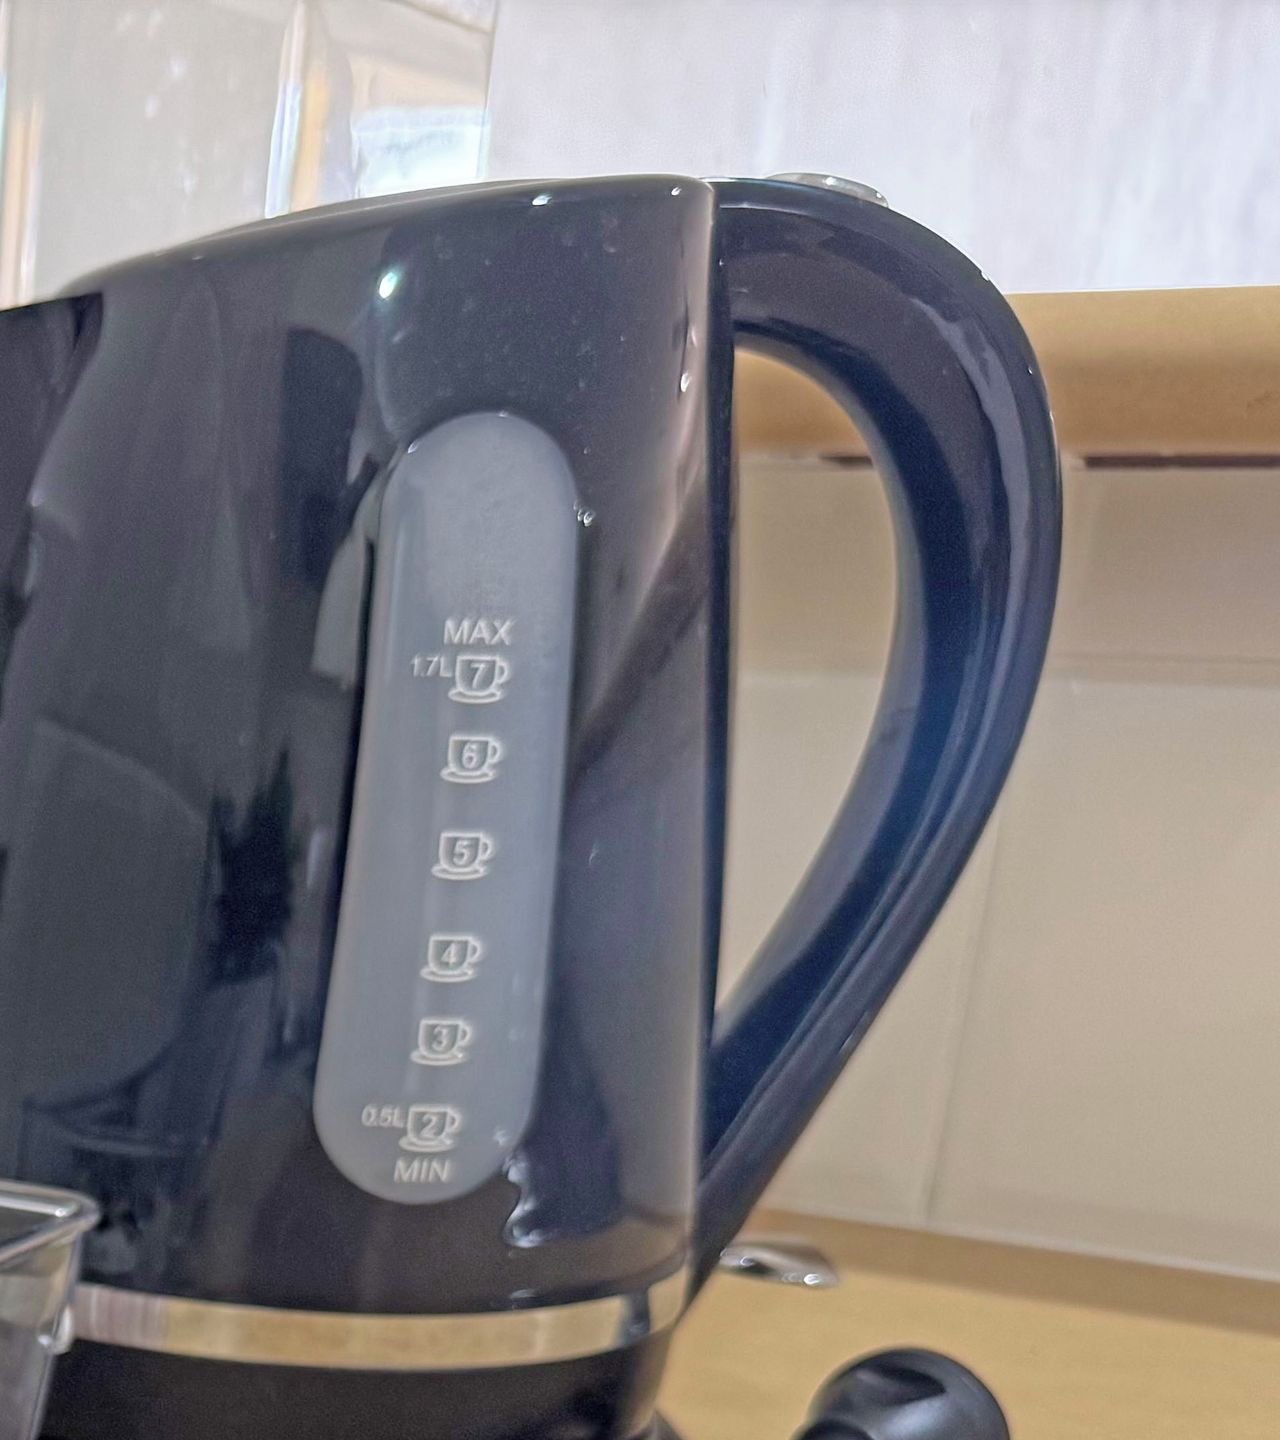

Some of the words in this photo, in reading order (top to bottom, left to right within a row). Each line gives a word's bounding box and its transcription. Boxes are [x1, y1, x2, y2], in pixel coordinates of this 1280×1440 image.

[443, 617, 516, 646] MAX
[470, 662, 489, 689] 7
[462, 741, 479, 769] 6
[453, 840, 470, 866] 5
[441, 942, 457, 967] 4
[432, 1025, 449, 1051] 3
[421, 1114, 438, 1139] 2
[393, 1156, 451, 1184] MIN
